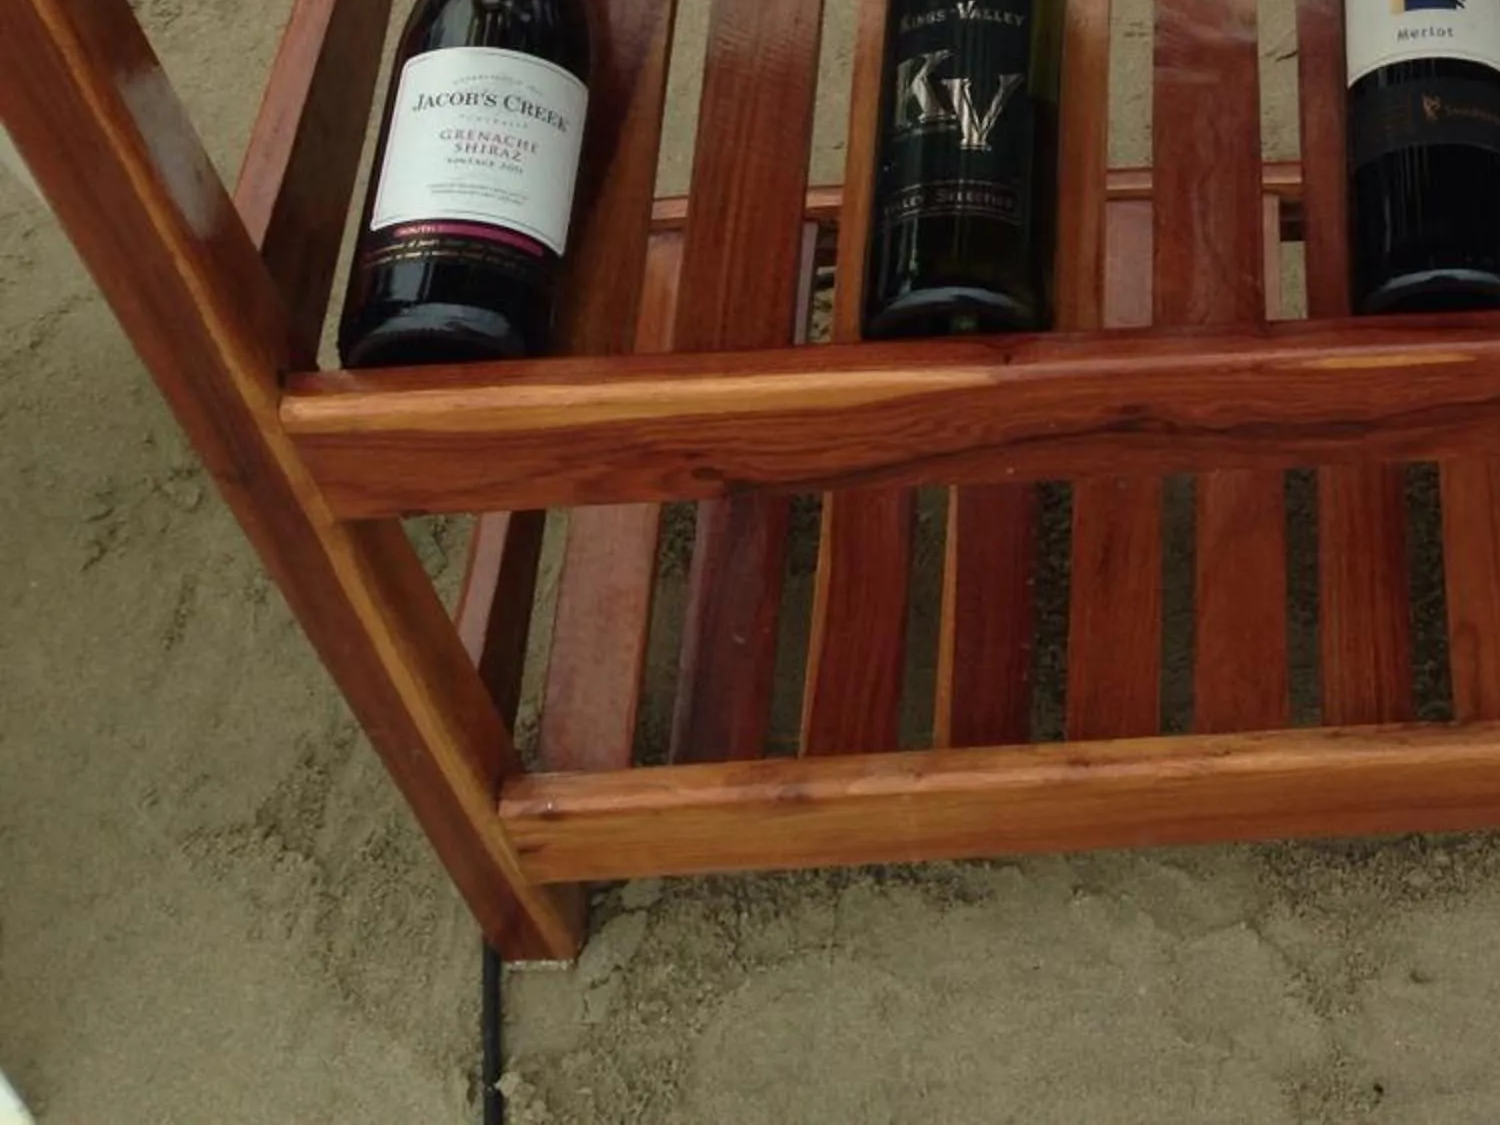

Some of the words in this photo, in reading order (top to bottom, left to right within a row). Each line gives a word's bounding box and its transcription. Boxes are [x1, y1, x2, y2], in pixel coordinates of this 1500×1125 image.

[955, 0, 1025, 26] VALLEY
[1397, 27, 1454, 43] Merlot
[412, 91, 498, 112] JACOB'S
[503, 94, 571, 133] CREEK
[439, 129, 539, 154] GRENACHE
[454, 143, 523, 162] SHIRAZ
